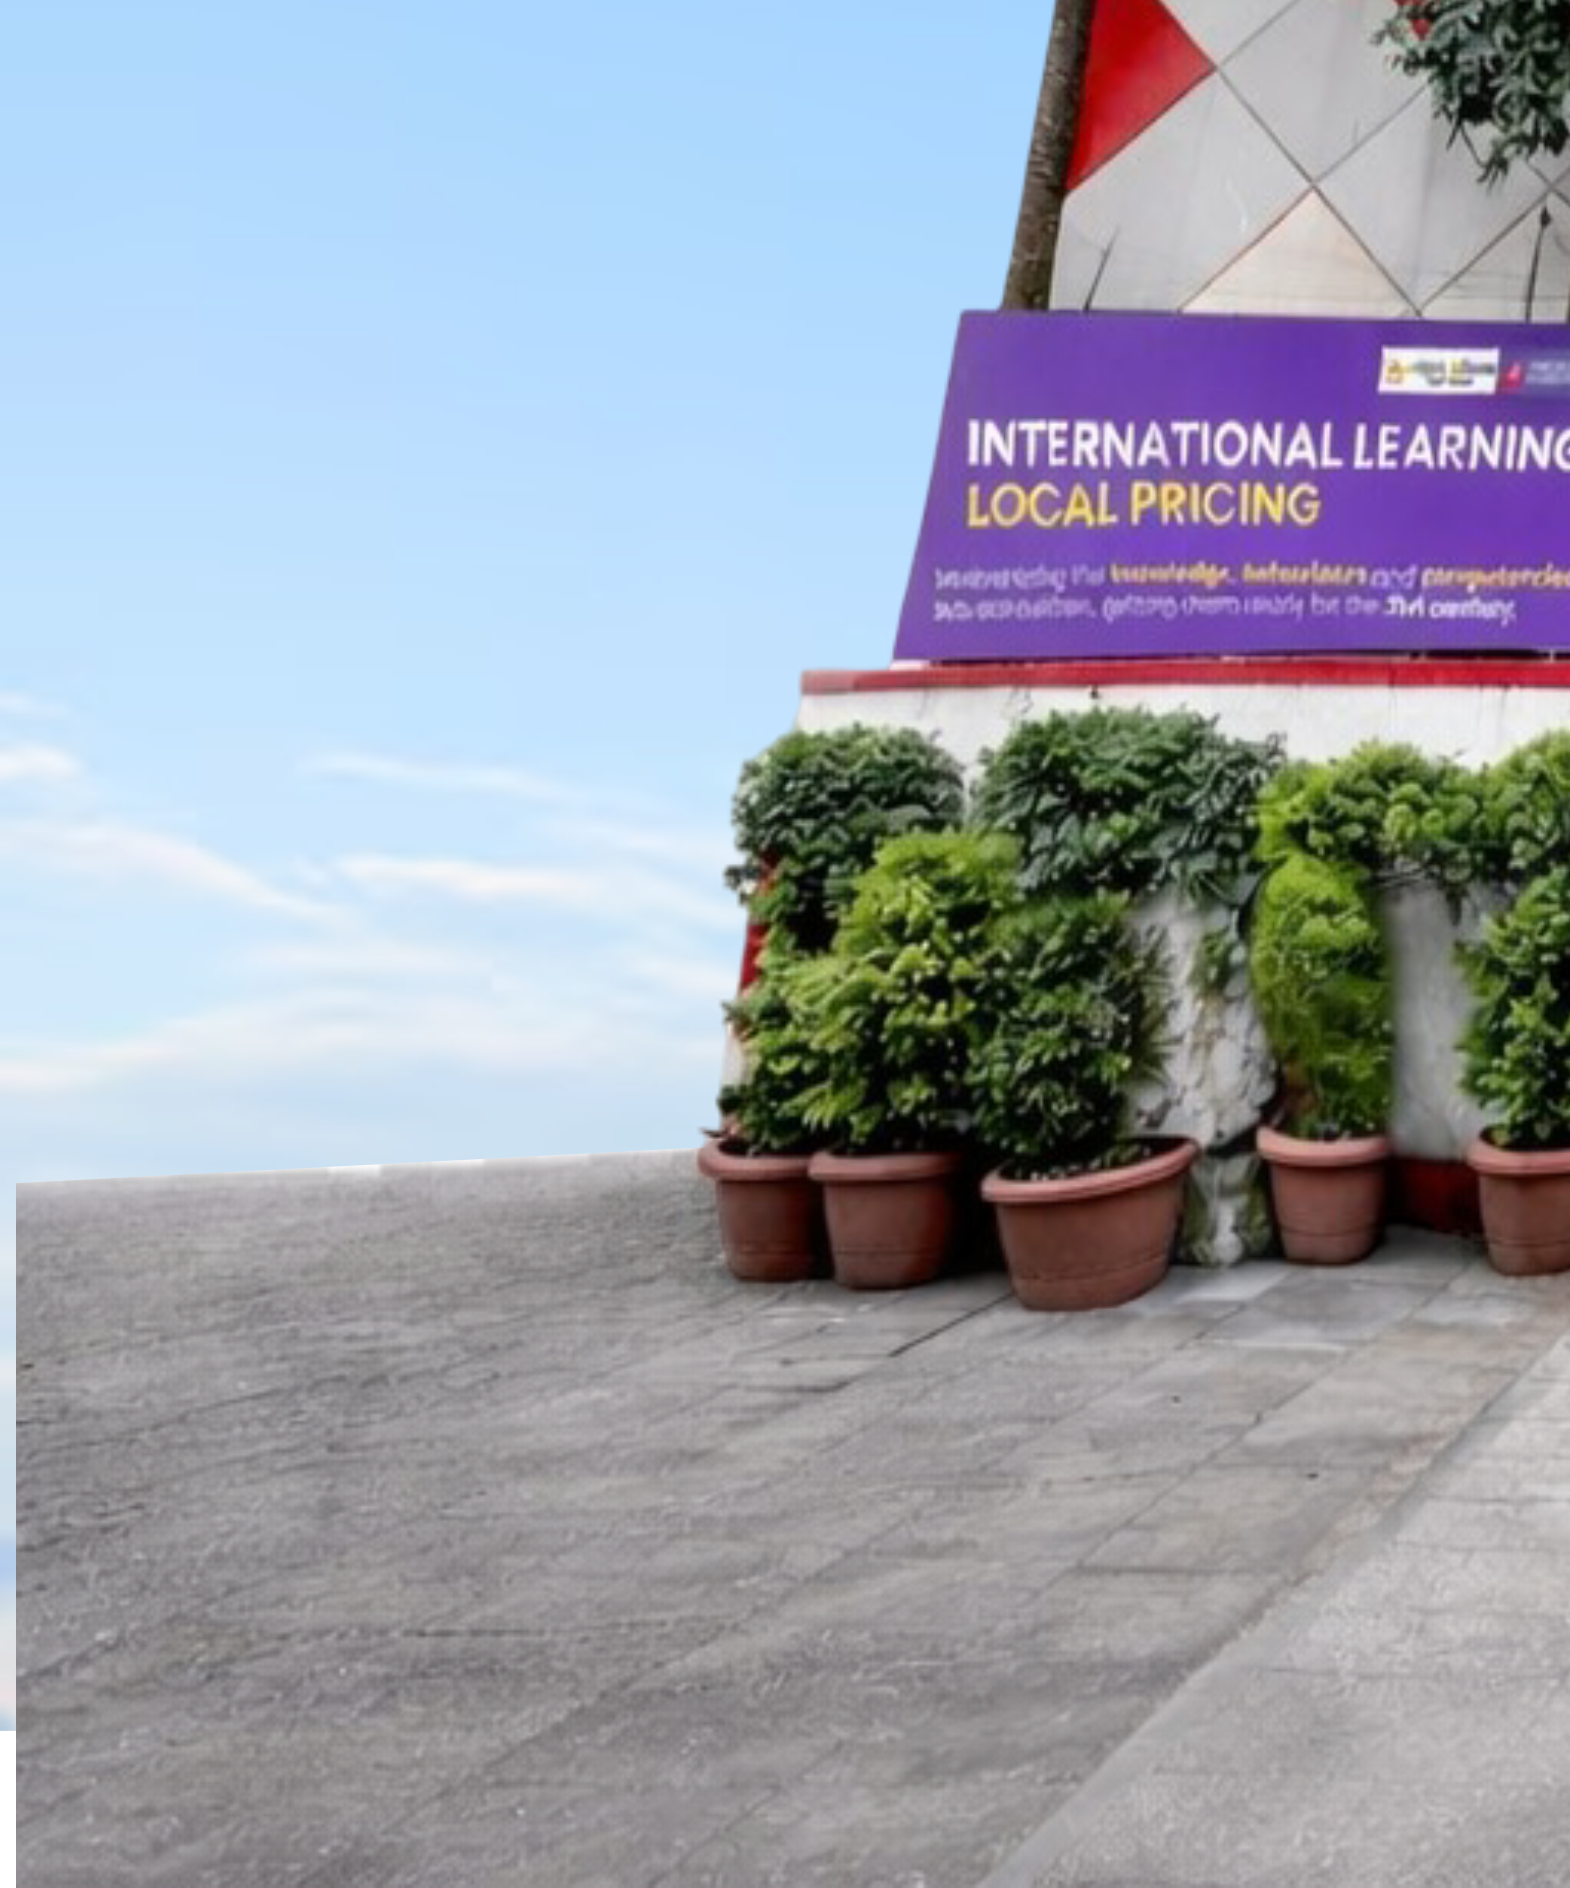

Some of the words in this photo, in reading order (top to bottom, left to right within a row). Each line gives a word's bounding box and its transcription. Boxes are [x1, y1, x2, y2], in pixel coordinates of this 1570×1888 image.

[967, 420, 1344, 468] INTERNATIONAL
[966, 483, 1118, 528] LOCAL
[1130, 482, 1322, 527] PRICING
